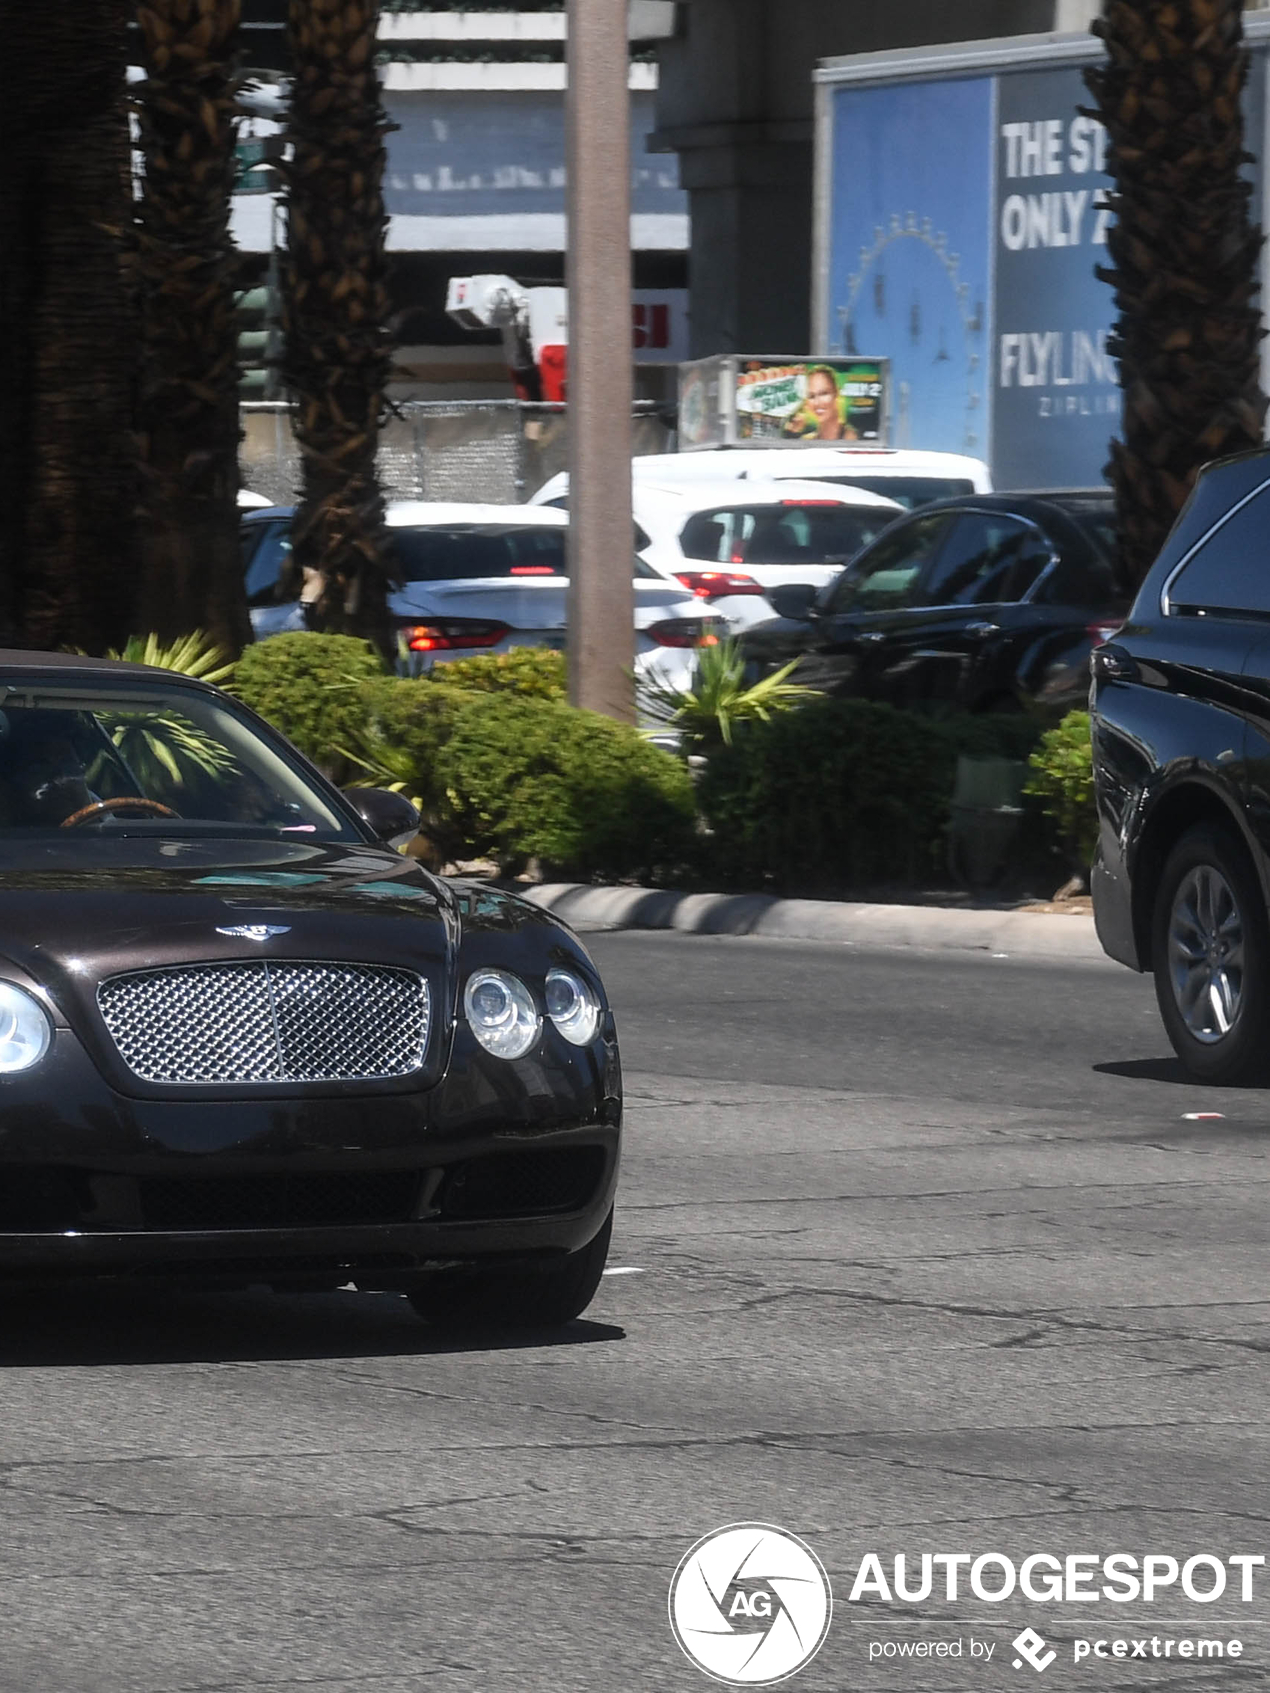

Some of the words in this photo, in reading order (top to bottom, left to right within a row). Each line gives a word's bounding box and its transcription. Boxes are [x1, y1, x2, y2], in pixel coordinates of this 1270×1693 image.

[1002, 119, 1063, 178] THE
[1069, 115, 1109, 173] ST
[1001, 189, 1088, 250] ONLY
[1039, 395, 1121, 417] ZIPLIN
